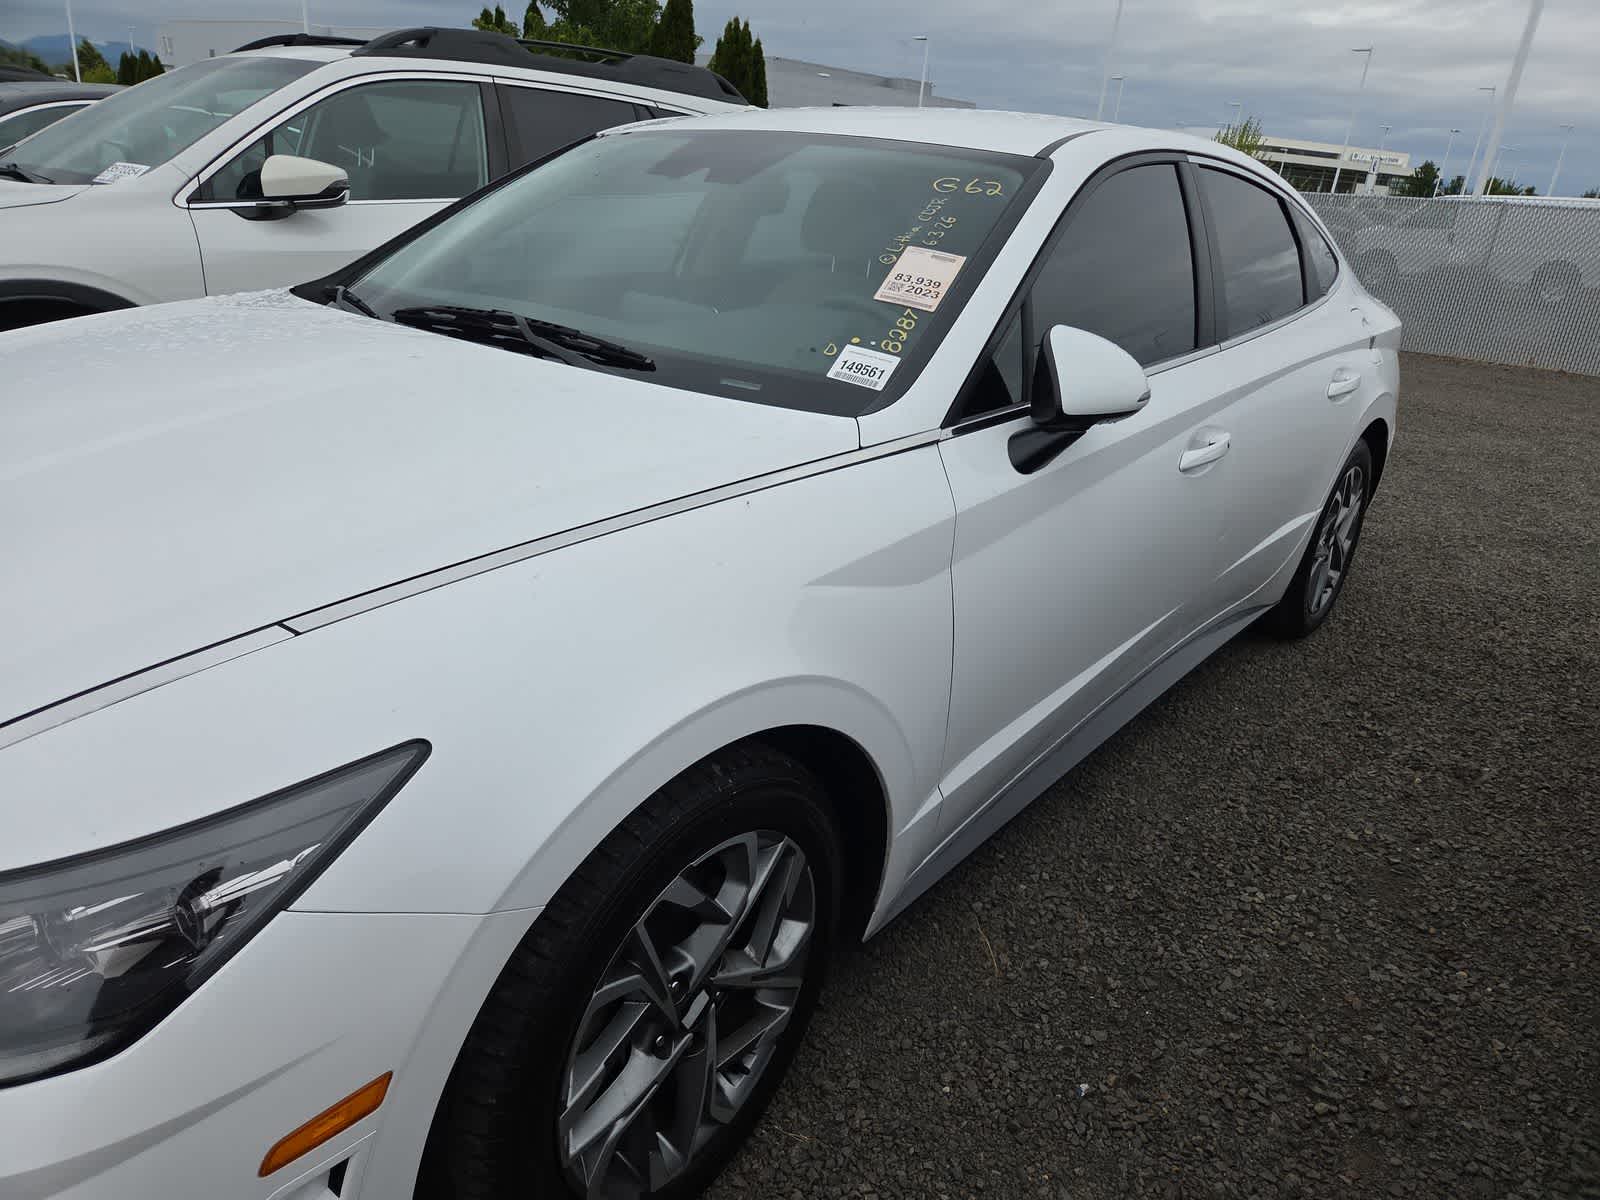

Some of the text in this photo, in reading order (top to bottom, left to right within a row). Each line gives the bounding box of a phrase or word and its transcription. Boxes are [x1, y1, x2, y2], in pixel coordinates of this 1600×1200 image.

[905, 285, 941, 299] 2023
[880, 308, 918, 353] 8287
[840, 359, 885, 380] 149561
